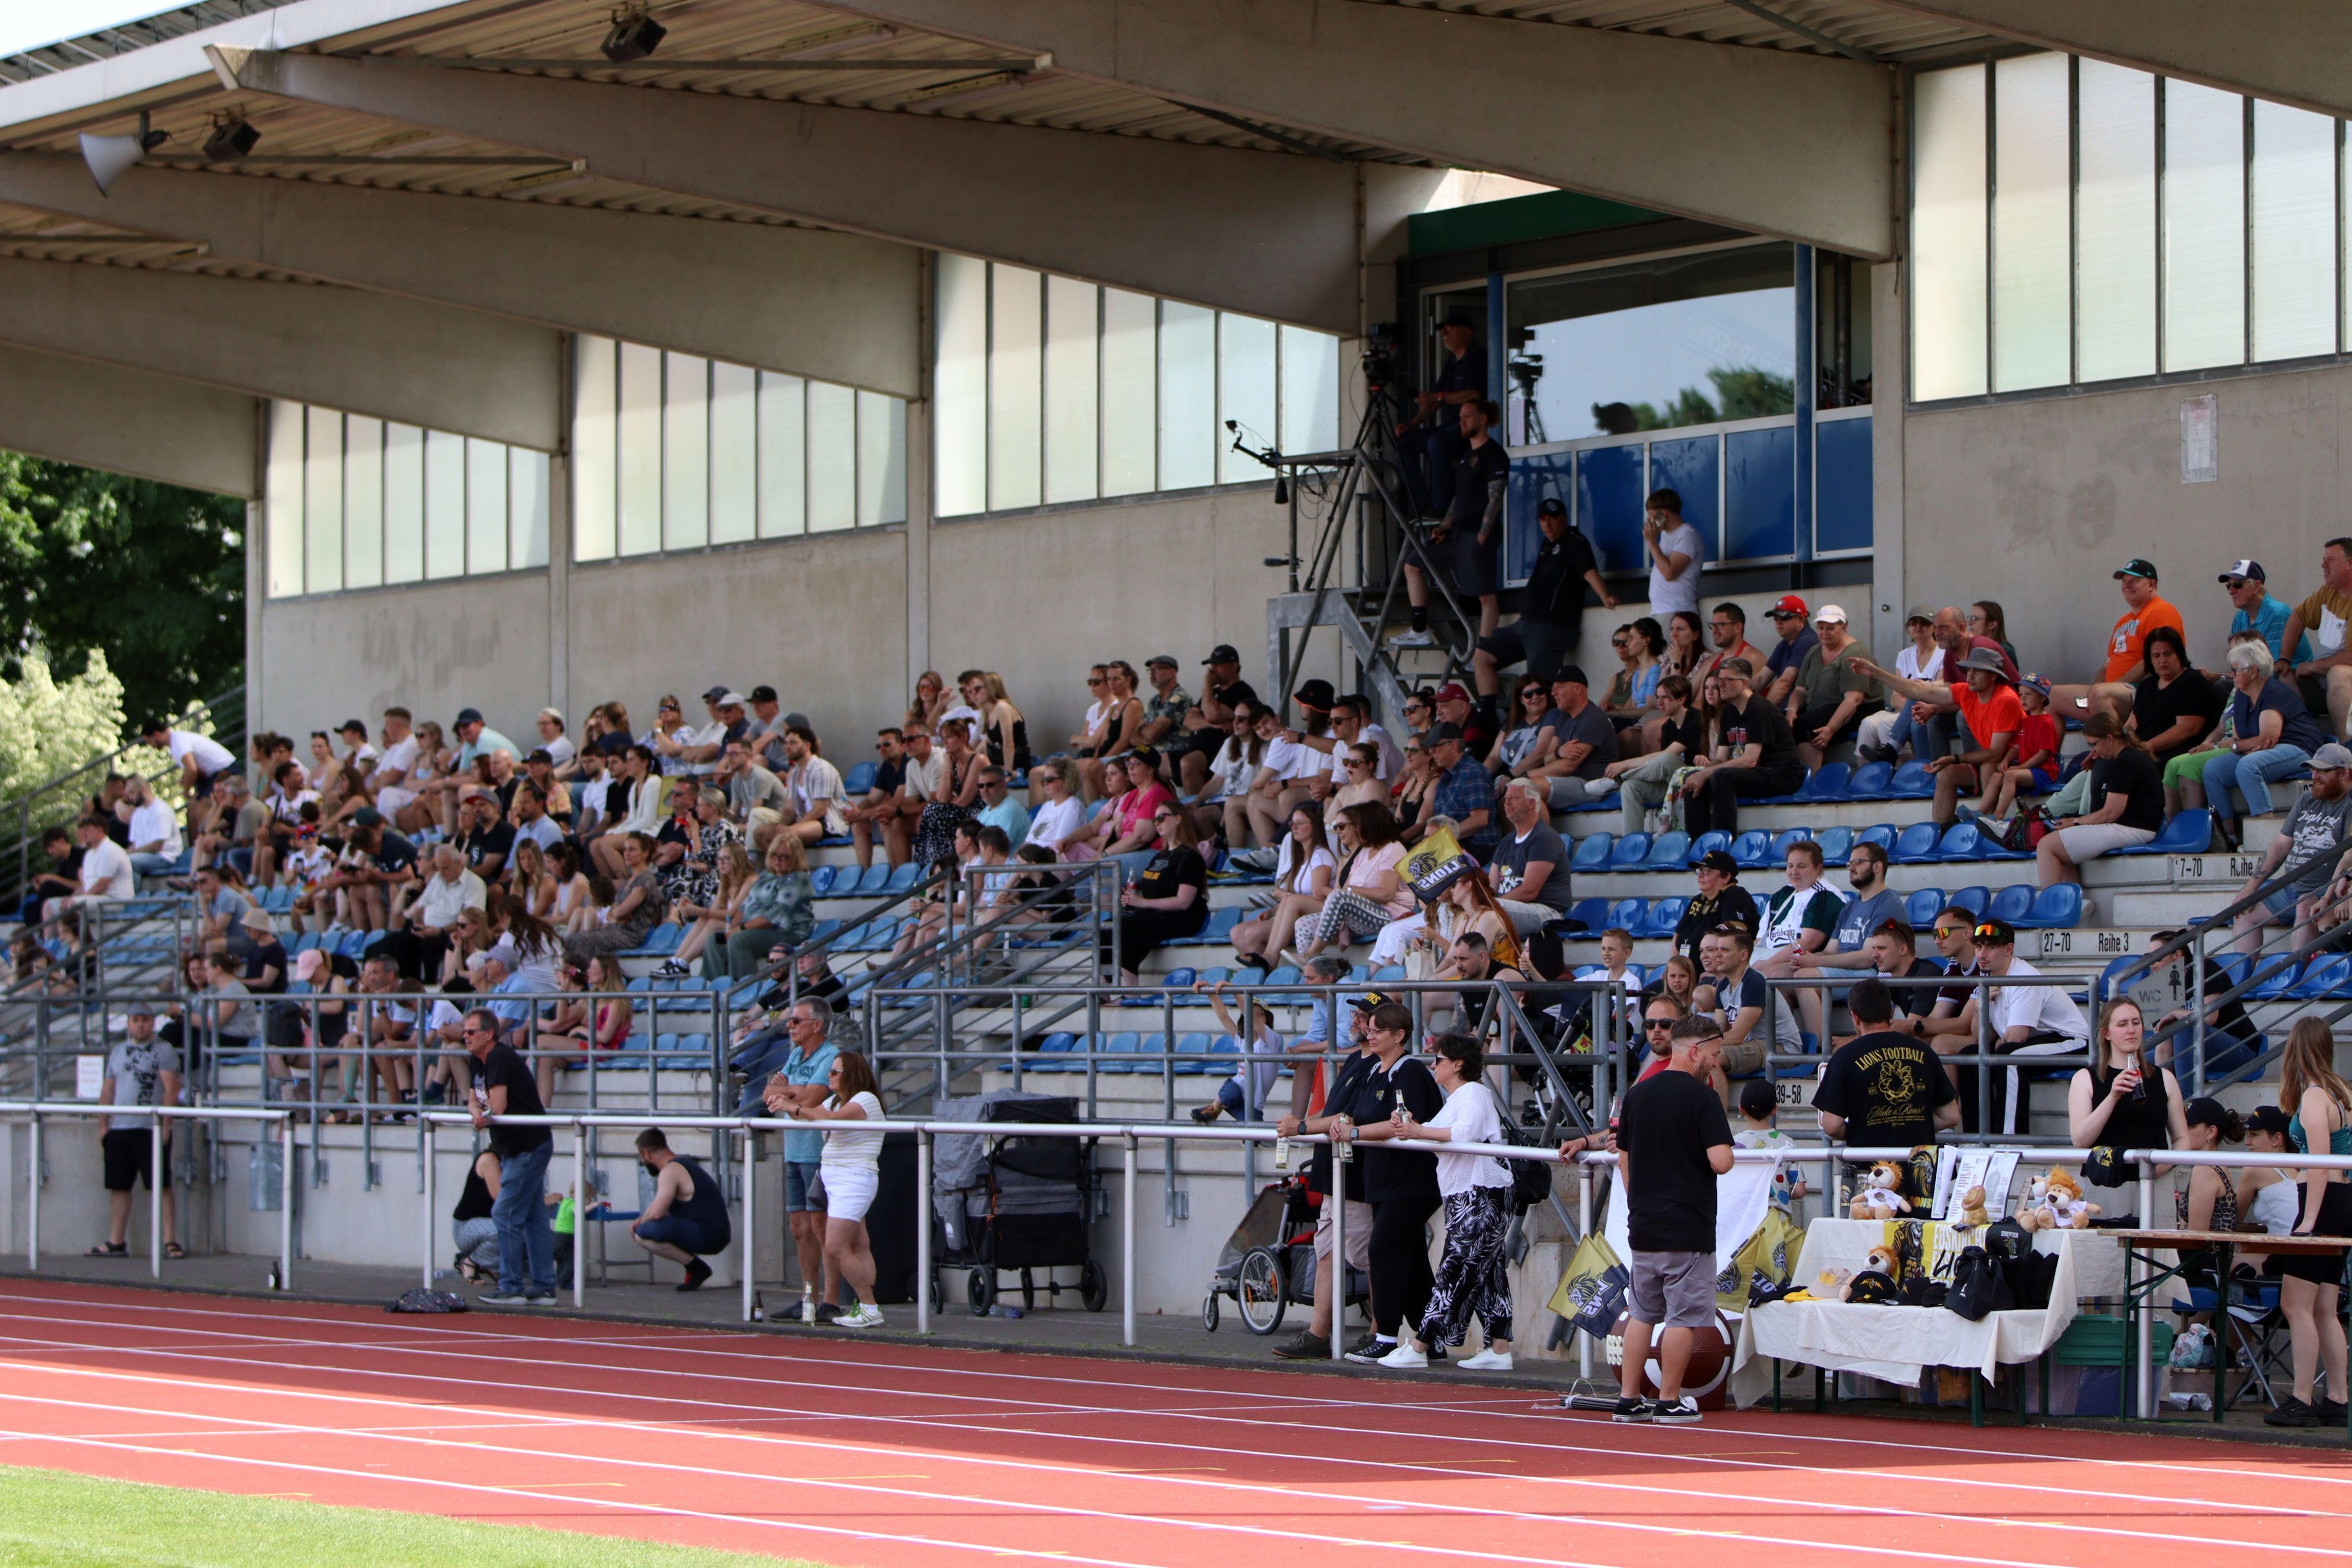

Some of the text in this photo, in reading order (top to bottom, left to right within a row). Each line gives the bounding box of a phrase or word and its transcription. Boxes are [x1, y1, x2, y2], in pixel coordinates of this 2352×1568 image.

[2175, 858, 2202, 877] 7-70
[1769, 926, 1796, 942] Carlsberg
[2044, 932, 2129, 952] 27-70 Reihe 3
[2138, 989, 2161, 1003] WC
[1854, 1047, 1925, 1072] LIONS FOOTBALL
